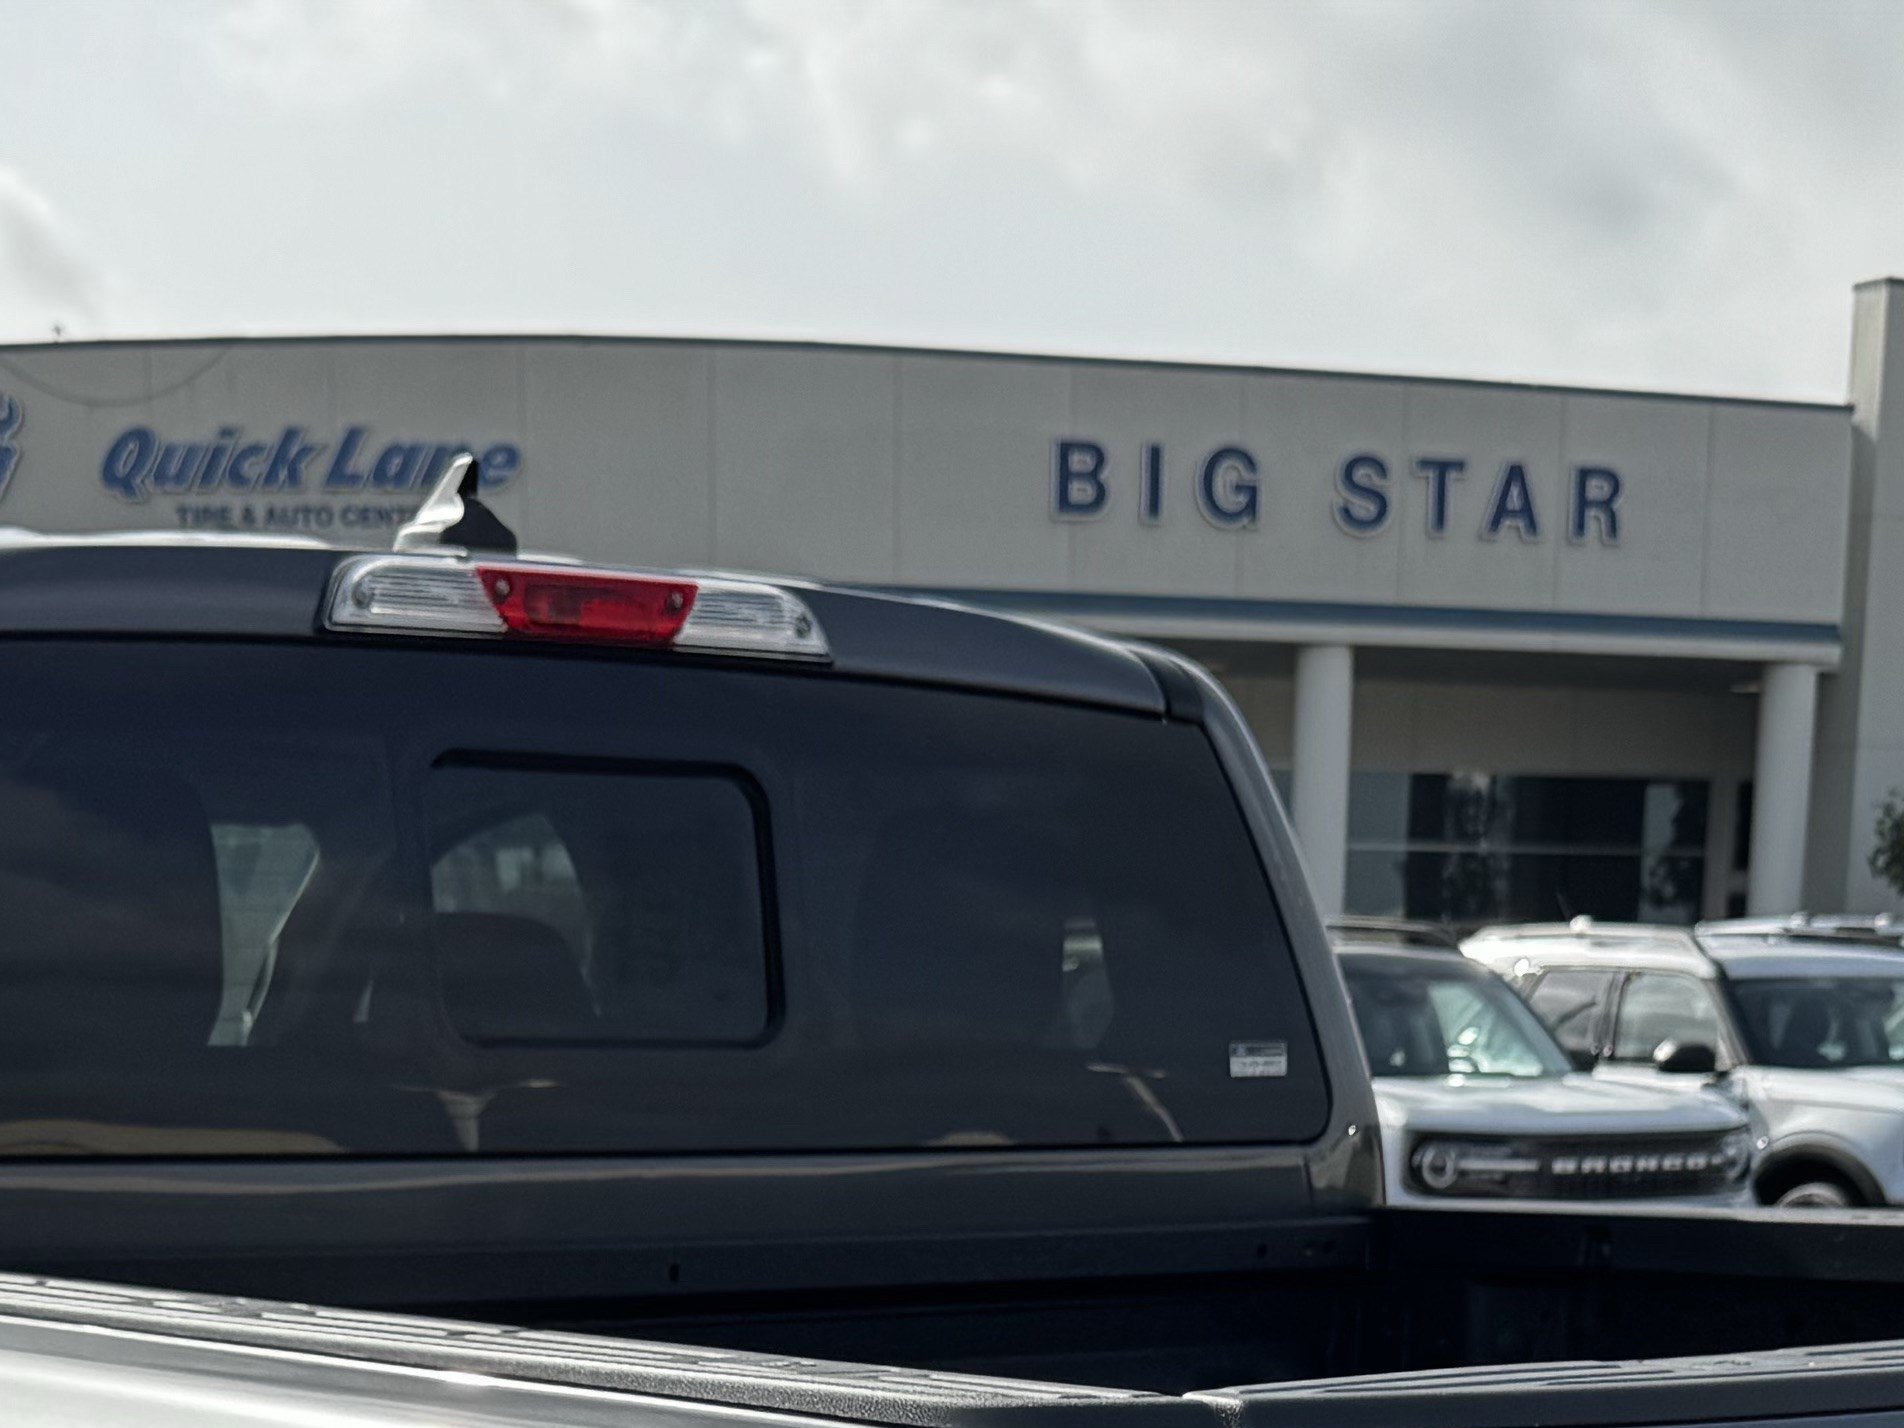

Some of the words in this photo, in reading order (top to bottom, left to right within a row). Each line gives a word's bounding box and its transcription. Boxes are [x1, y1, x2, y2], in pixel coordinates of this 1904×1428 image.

[101, 424, 322, 499] Quick
[1056, 438, 1260, 526] BIG
[1336, 454, 1623, 540] STAR
[175, 504, 234, 529] TIRE
[264, 503, 335, 529] AUTO
[339, 503, 419, 530] CENT
